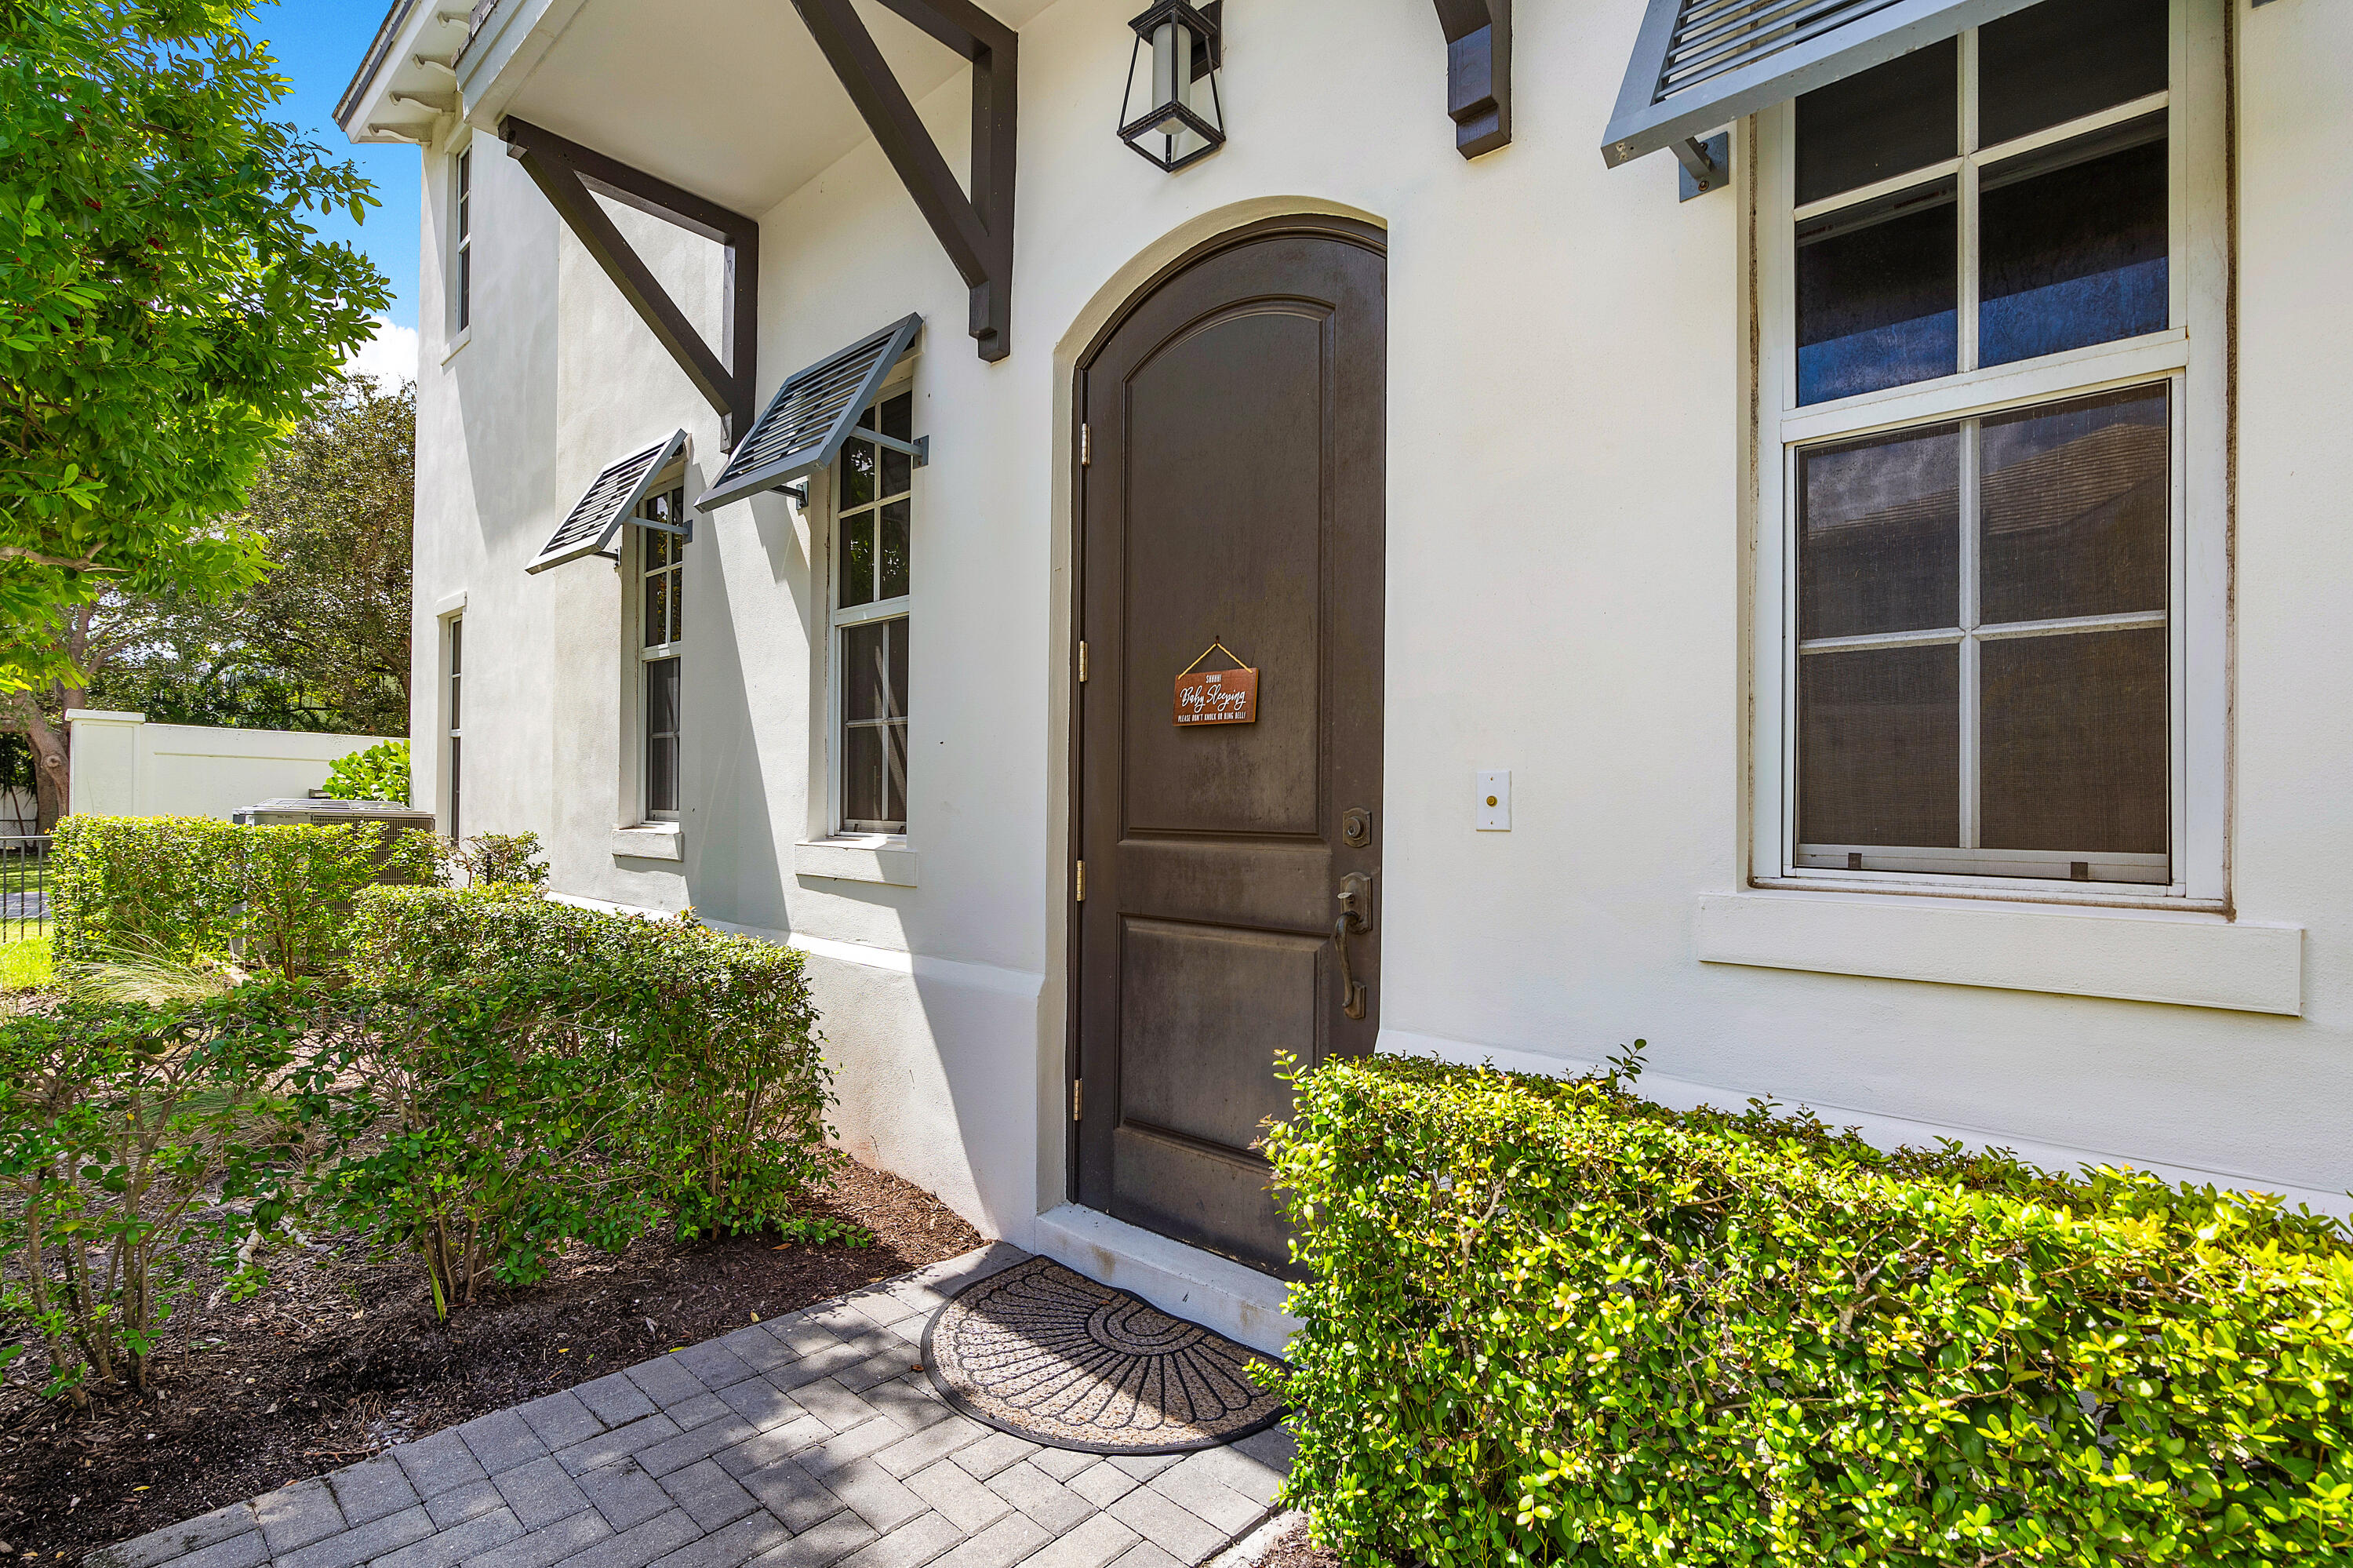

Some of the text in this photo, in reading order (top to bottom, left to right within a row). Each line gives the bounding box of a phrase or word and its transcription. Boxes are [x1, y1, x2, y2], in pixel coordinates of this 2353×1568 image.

[1180, 683, 1246, 713] Baby Sleeping
[1224, 711, 1234, 720] RING
[1235, 711, 1246, 719] BELL!
